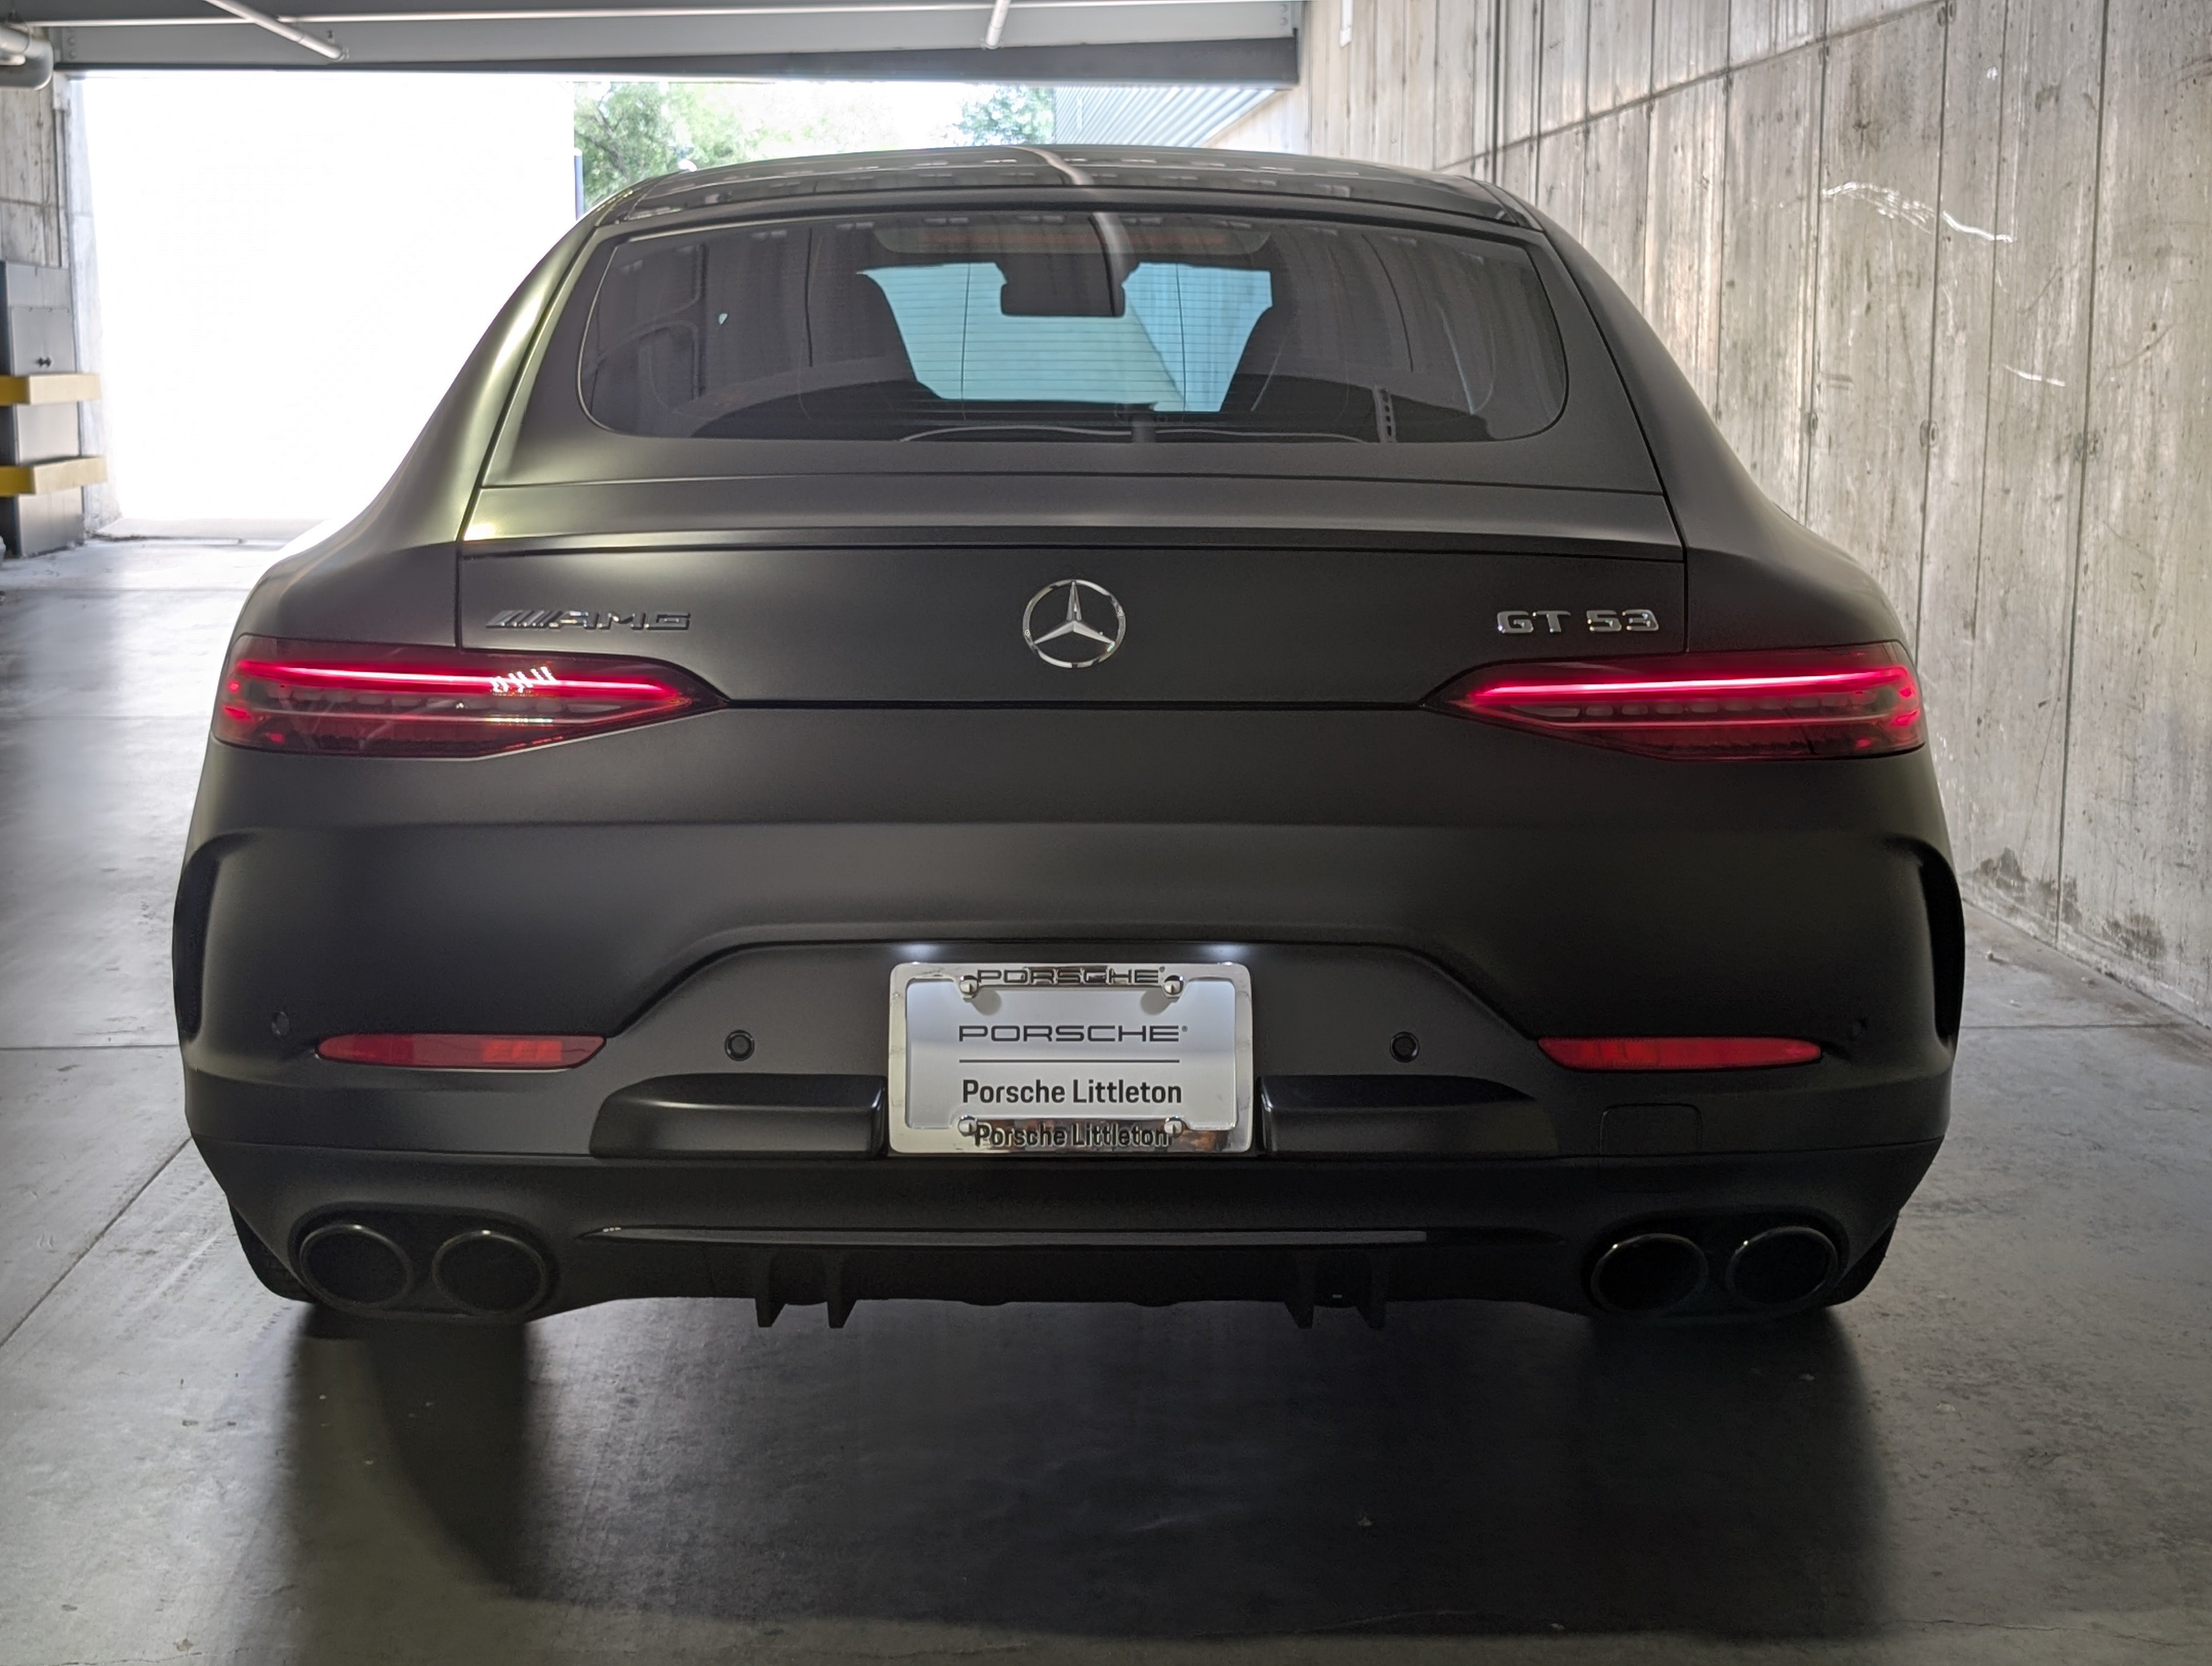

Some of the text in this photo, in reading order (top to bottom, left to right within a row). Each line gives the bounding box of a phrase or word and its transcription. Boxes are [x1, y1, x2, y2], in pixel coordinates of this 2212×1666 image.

[548, 610, 692, 631] AMG
[1496, 608, 1660, 633] GT 53
[962, 1079, 1182, 1104] Porsche Littleton
[974, 1122, 1172, 1147] Porsche Littleton
